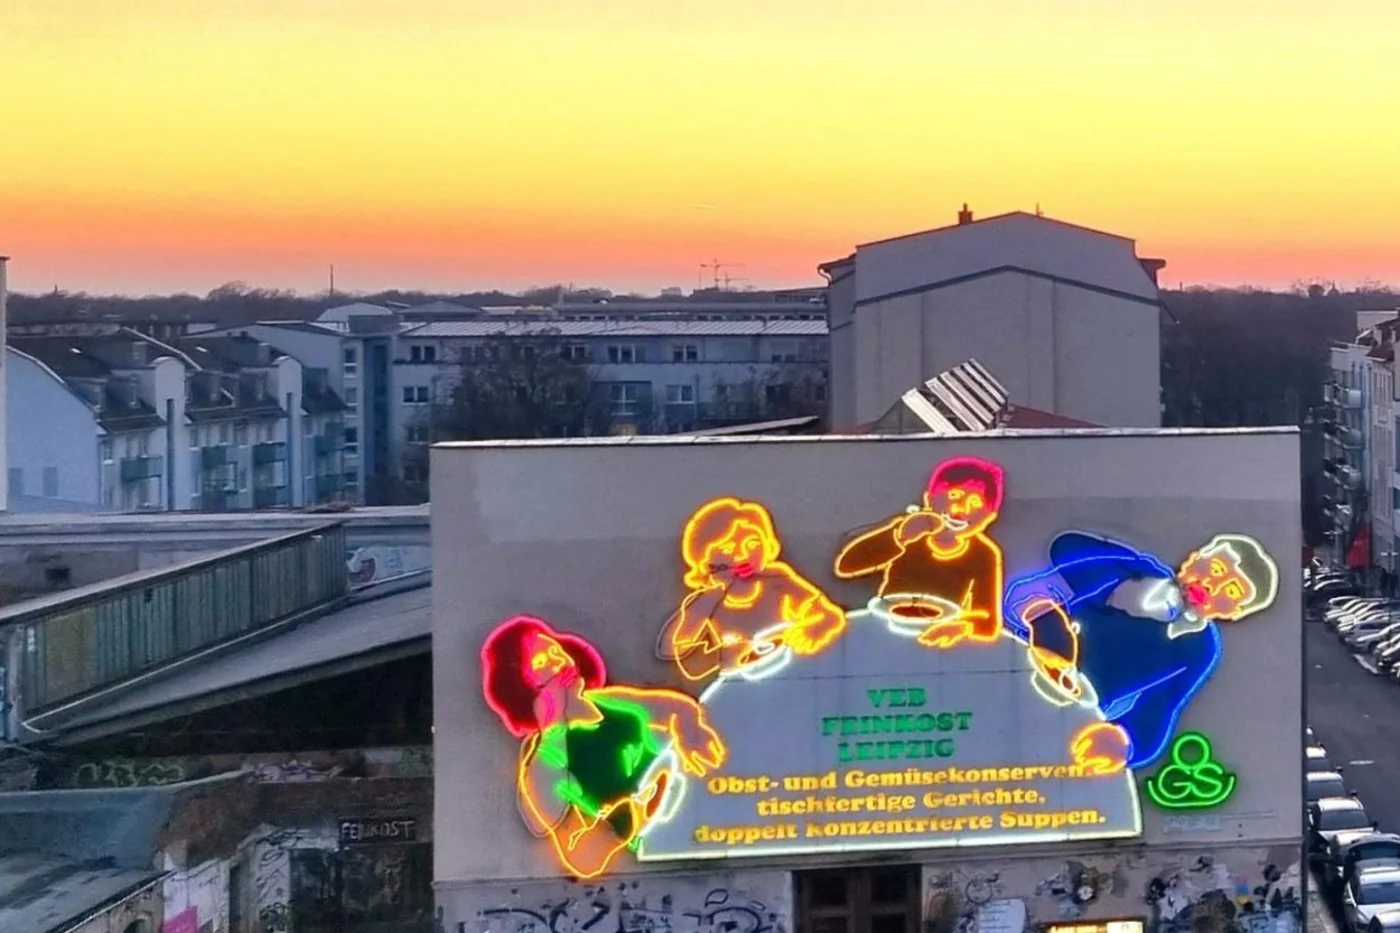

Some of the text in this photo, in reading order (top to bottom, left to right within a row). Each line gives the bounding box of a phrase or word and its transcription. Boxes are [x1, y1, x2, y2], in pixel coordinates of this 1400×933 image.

[867, 688, 926, 707] VEB
[822, 712, 972, 736] FEINKOST
[838, 738, 955, 762] LEIPZIG
[707, 774, 779, 795] Obst-
[783, 771, 837, 791] und
[757, 794, 916, 816] tischfertige
[694, 824, 798, 844] doppelt
[1000, 809, 1106, 829] Suppen.
